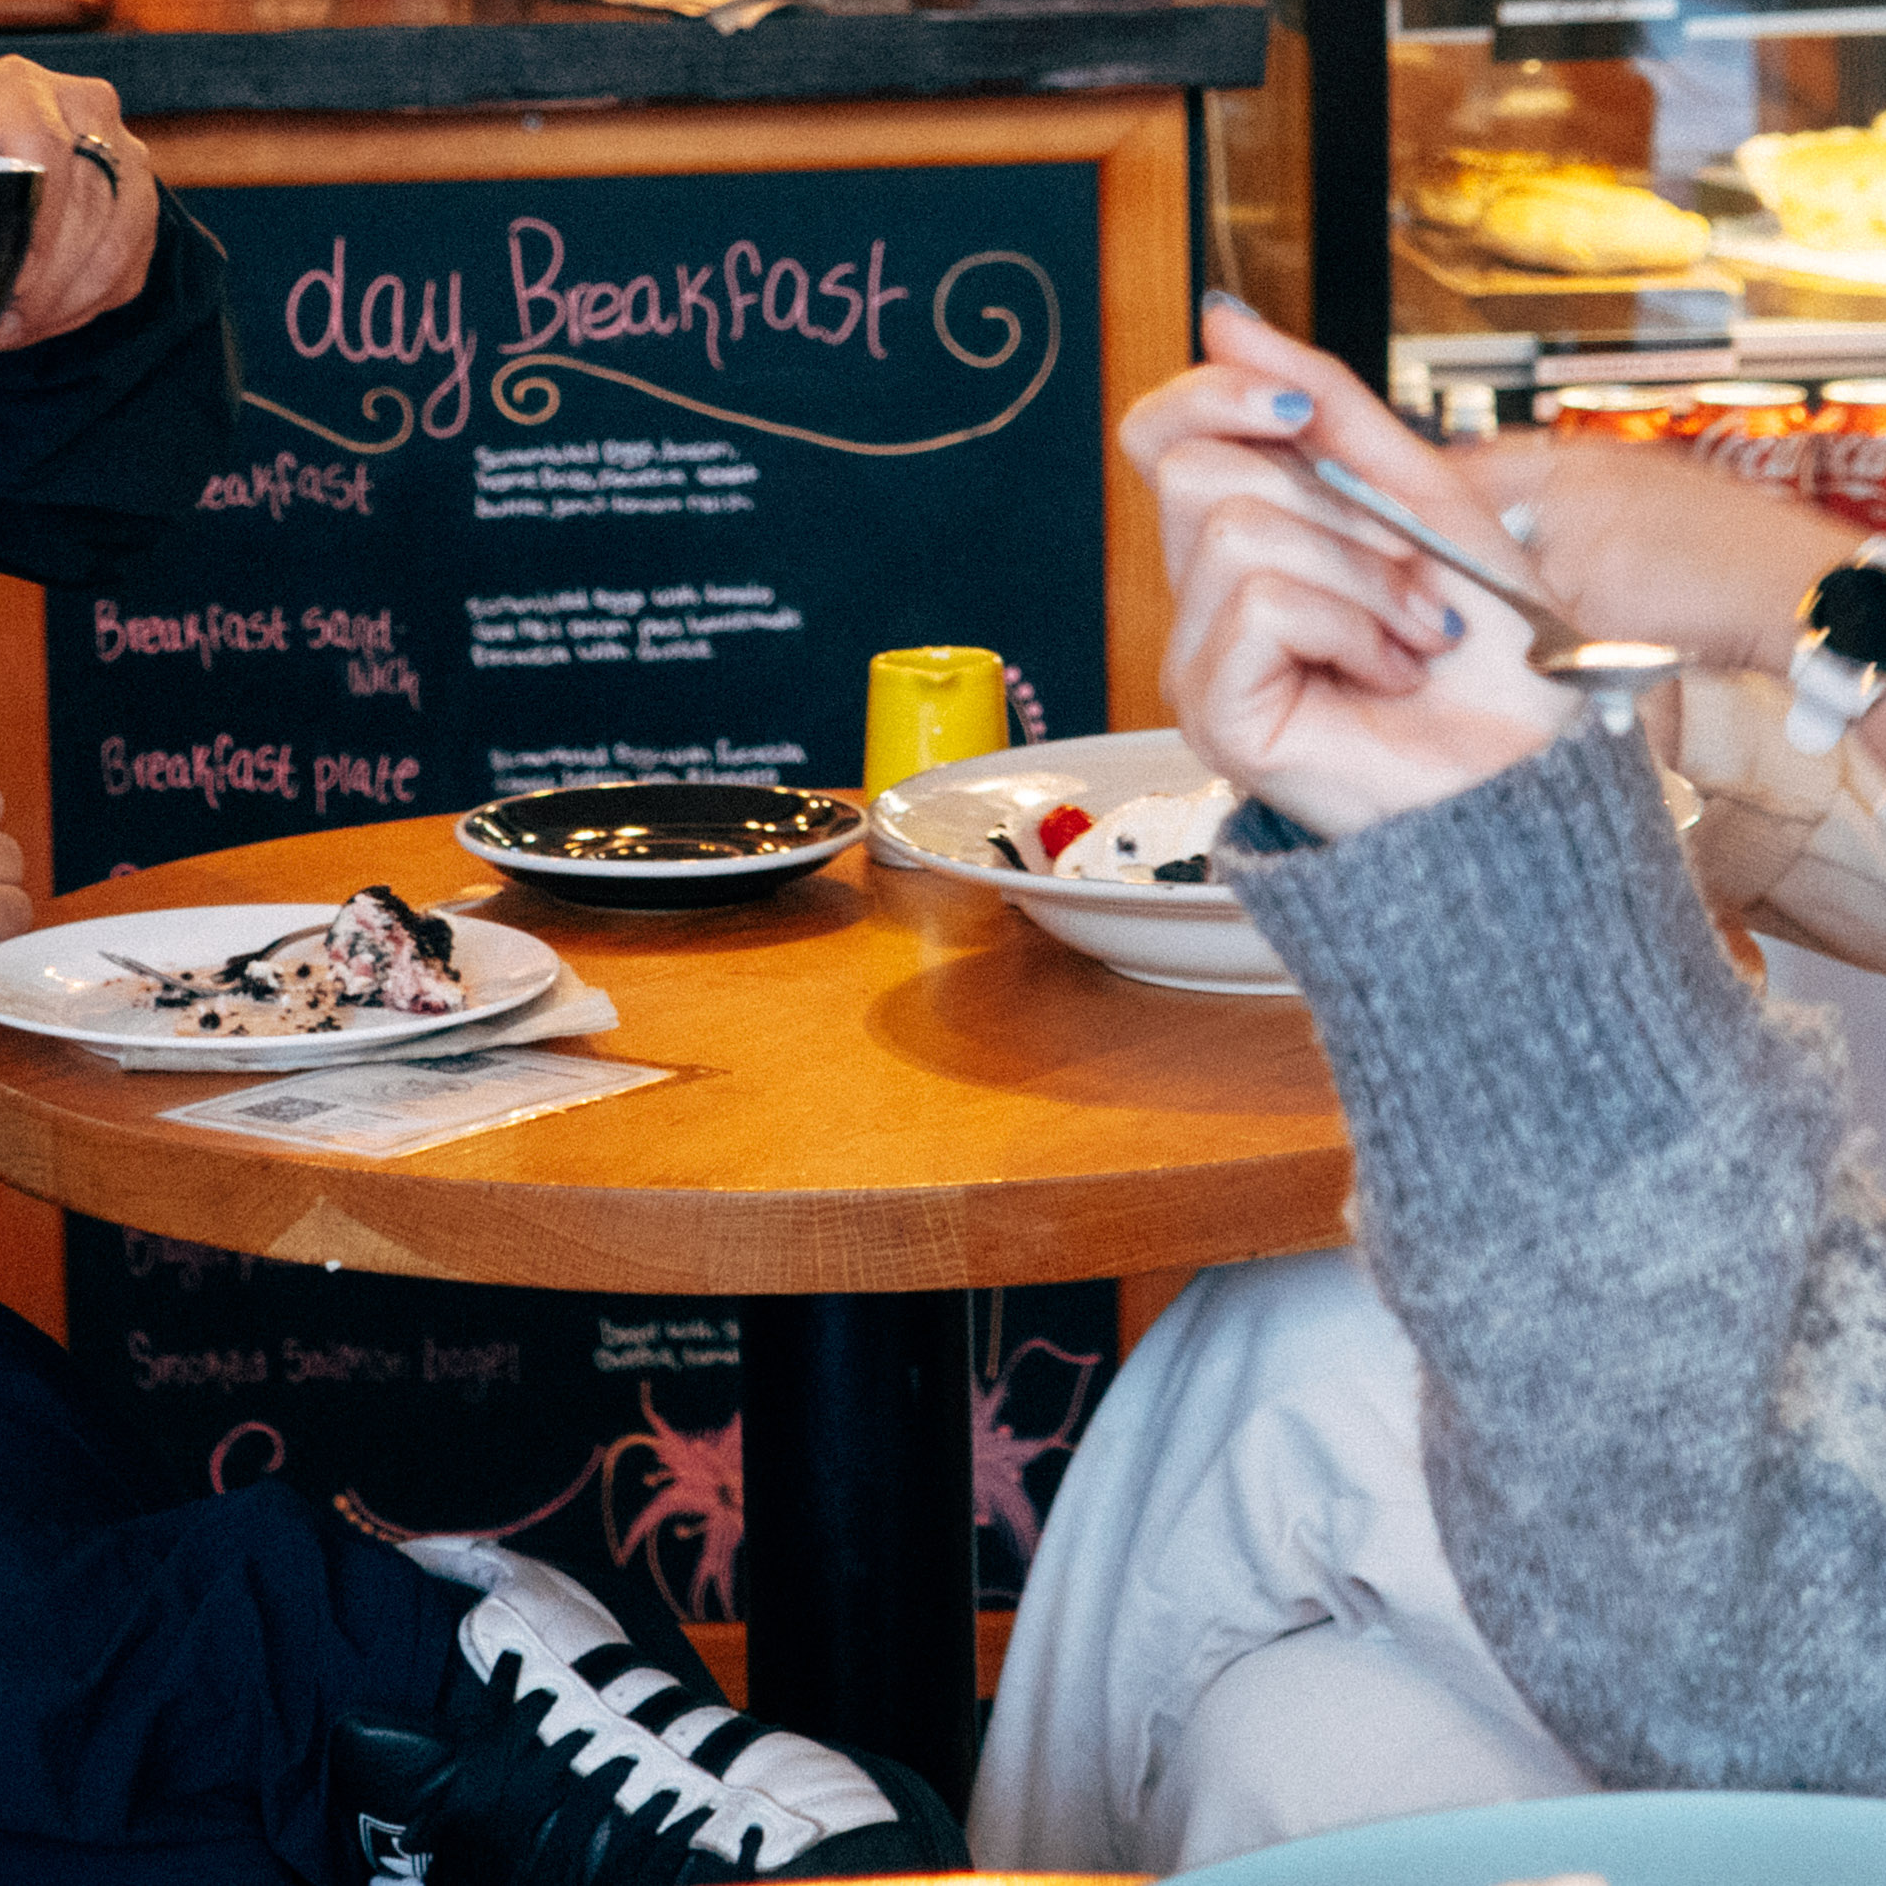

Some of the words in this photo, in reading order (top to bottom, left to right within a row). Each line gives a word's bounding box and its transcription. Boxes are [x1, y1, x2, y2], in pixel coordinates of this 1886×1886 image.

[285, 236, 478, 438] day
[499, 216, 909, 369] Breakfast
[195, 451, 374, 521] eakfast
[94, 599, 290, 670] Breakfast
[100, 732, 299, 810] Breakfast
[313, 753, 420, 814] plate
